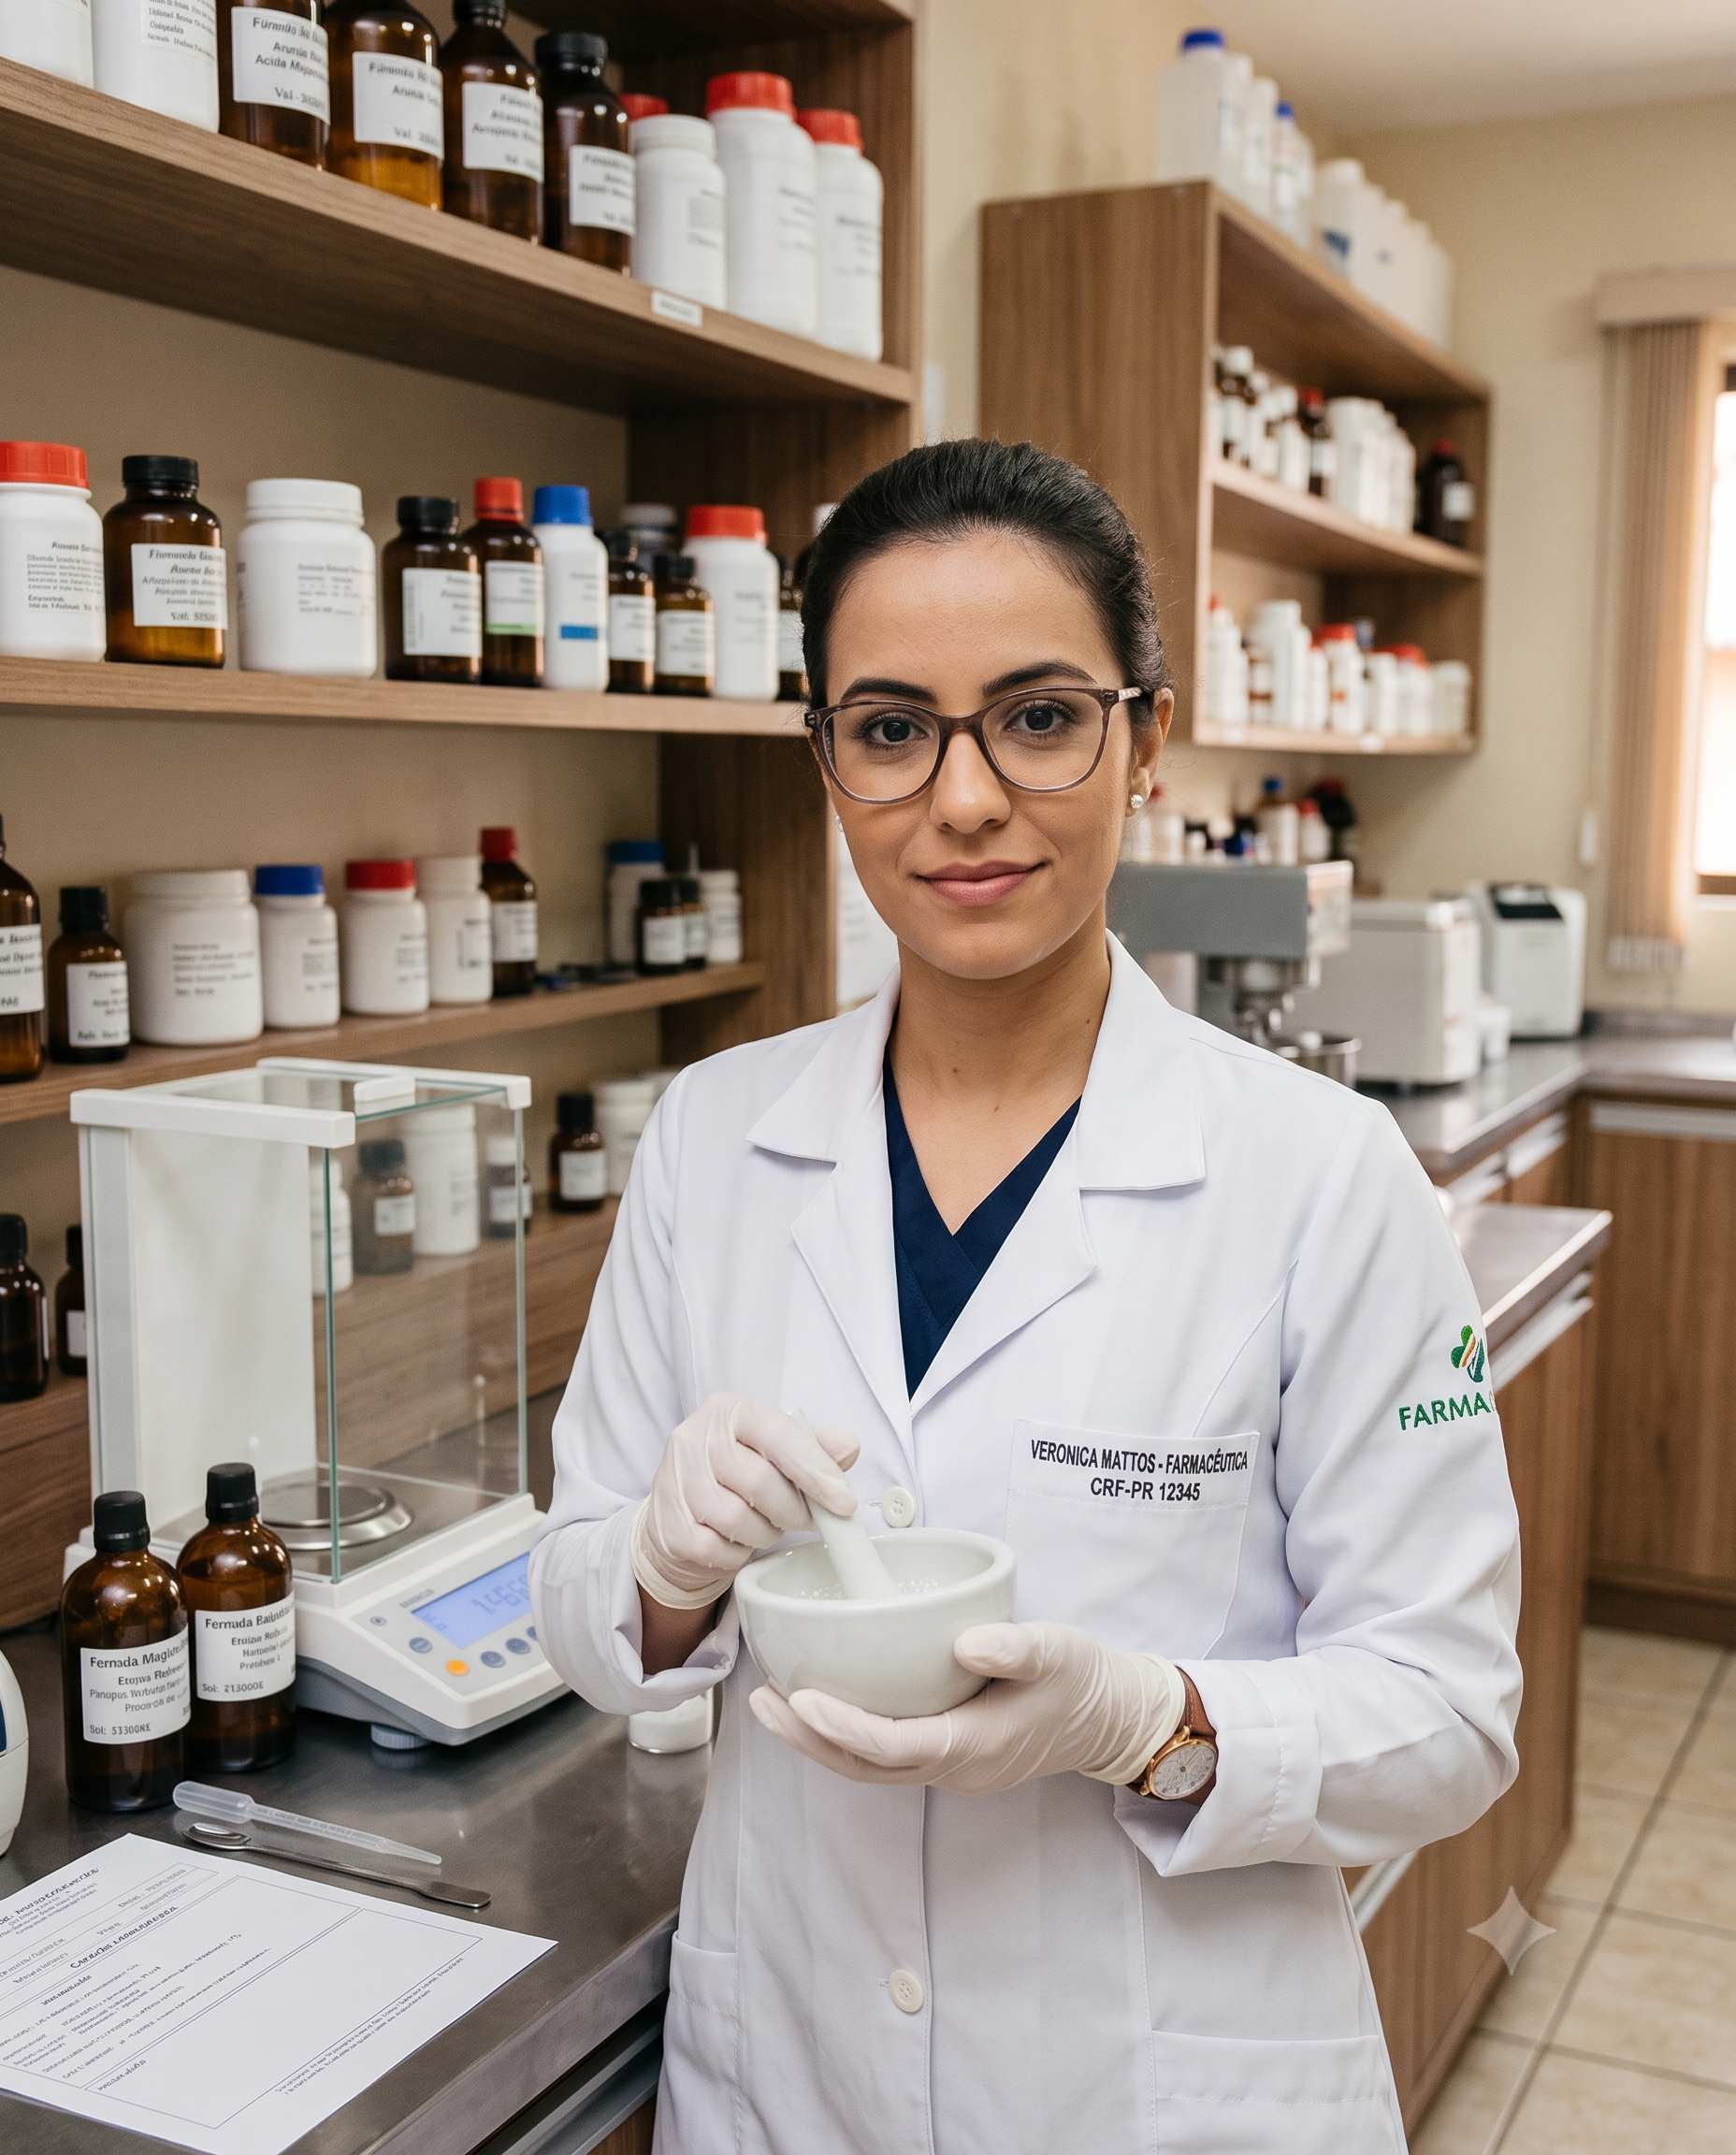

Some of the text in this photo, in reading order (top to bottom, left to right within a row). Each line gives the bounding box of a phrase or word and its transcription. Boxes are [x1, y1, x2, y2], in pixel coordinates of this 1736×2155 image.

[1399, 1391, 1495, 1431] FARMA
[1031, 1439, 1098, 1468] VERONICA
[1101, 1448, 1156, 1474] MATTOS
[1165, 1447, 1248, 1475] FARMACÉUTICA
[1091, 1477, 1201, 1501] CRF-PR 12345
[90, 1656, 138, 1669] Fernada
